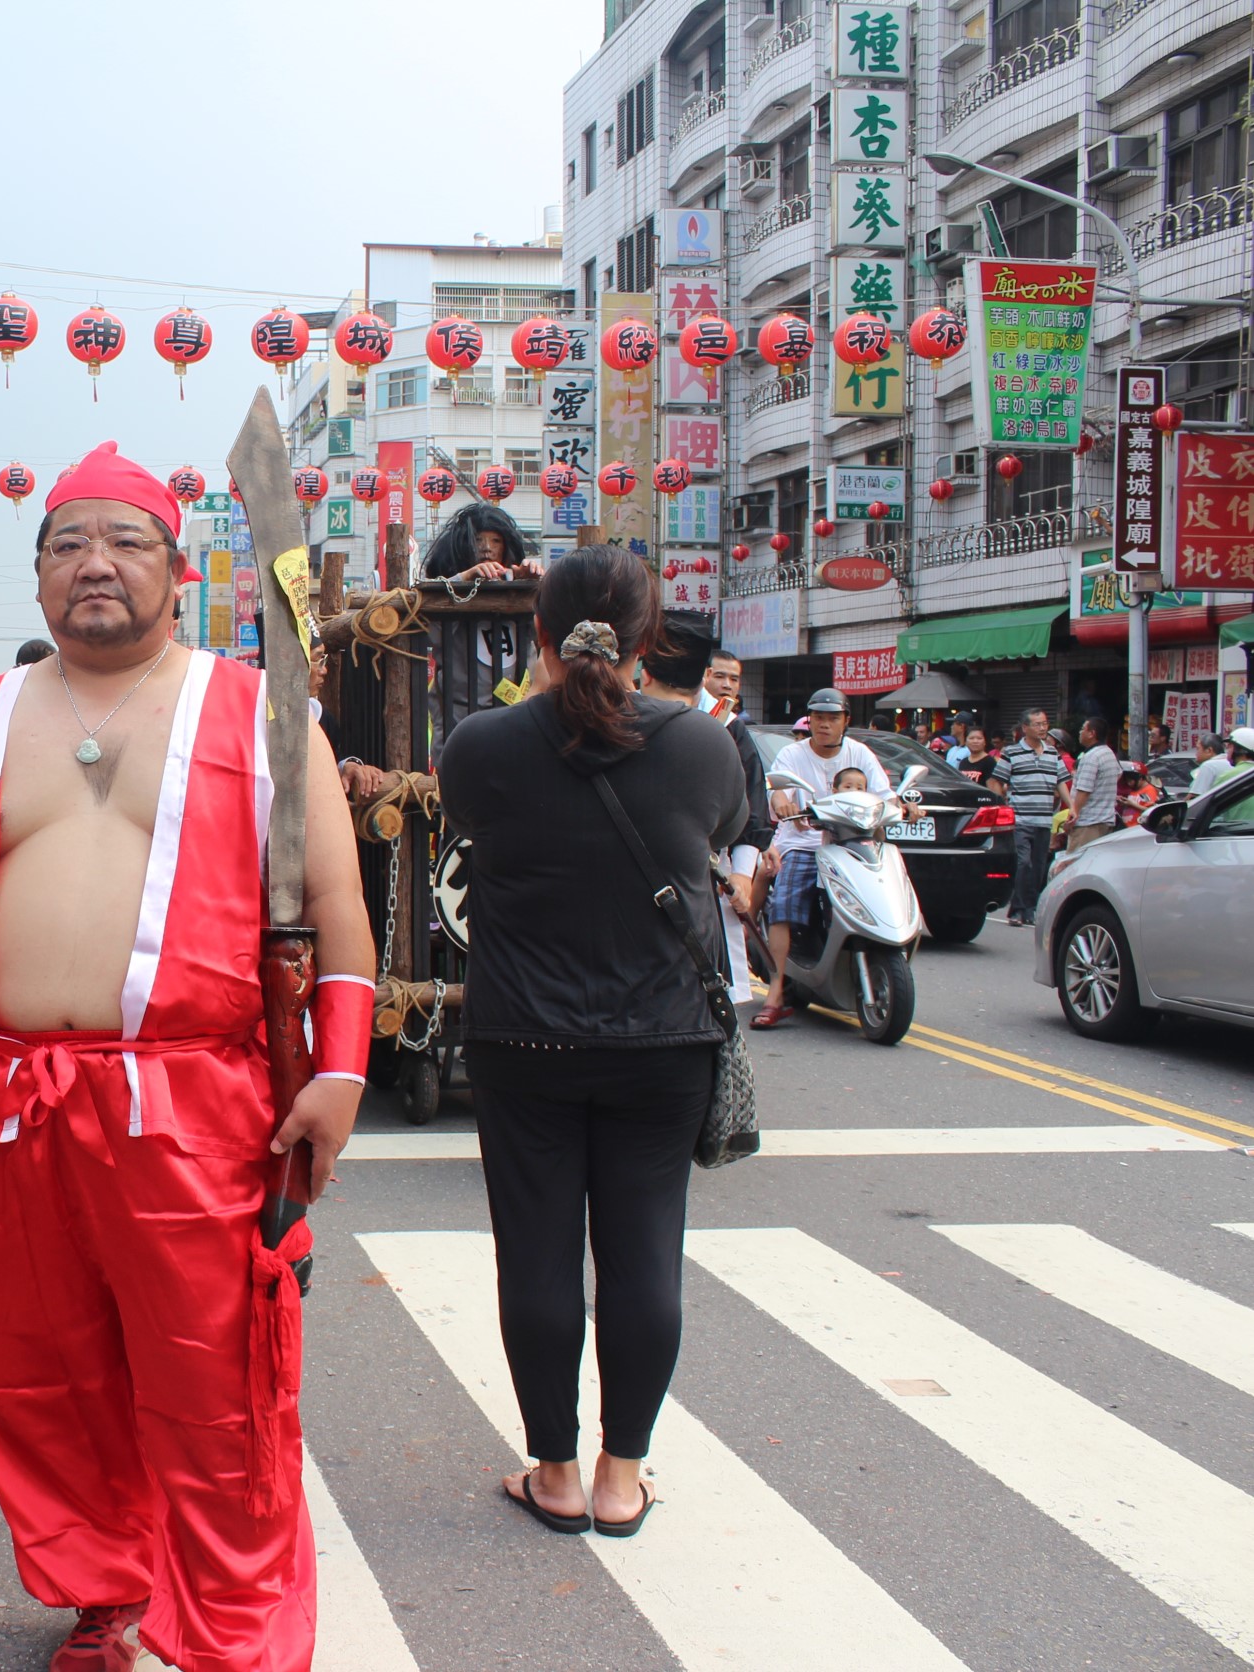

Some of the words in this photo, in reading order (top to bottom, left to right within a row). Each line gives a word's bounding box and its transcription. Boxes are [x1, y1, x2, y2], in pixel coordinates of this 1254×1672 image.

[73, 317, 123, 357] 神
[163, 313, 209, 358] 尊
[255, 313, 299, 359] 隍
[347, 318, 392, 360] 城
[435, 321, 482, 362] 侯
[525, 323, 569, 364] 靖
[693, 321, 731, 362] 邑
[772, 318, 814, 360] 嘉
[847, 320, 889, 357] 祝
[927, 312, 967, 350] 恭
[1120, 410, 1154, 424] 國定古
[5, 467, 29, 495] 邑
[170, 472, 200, 498] 侯
[355, 470, 380, 497] 尊
[422, 474, 454, 498] 神
[482, 471, 513, 498] 聖
[546, 469, 576, 496] 誕
[605, 465, 635, 491] 千
[657, 467, 689, 490] 秋
[1125, 426, 1154, 545] 嘉義城隍廟
